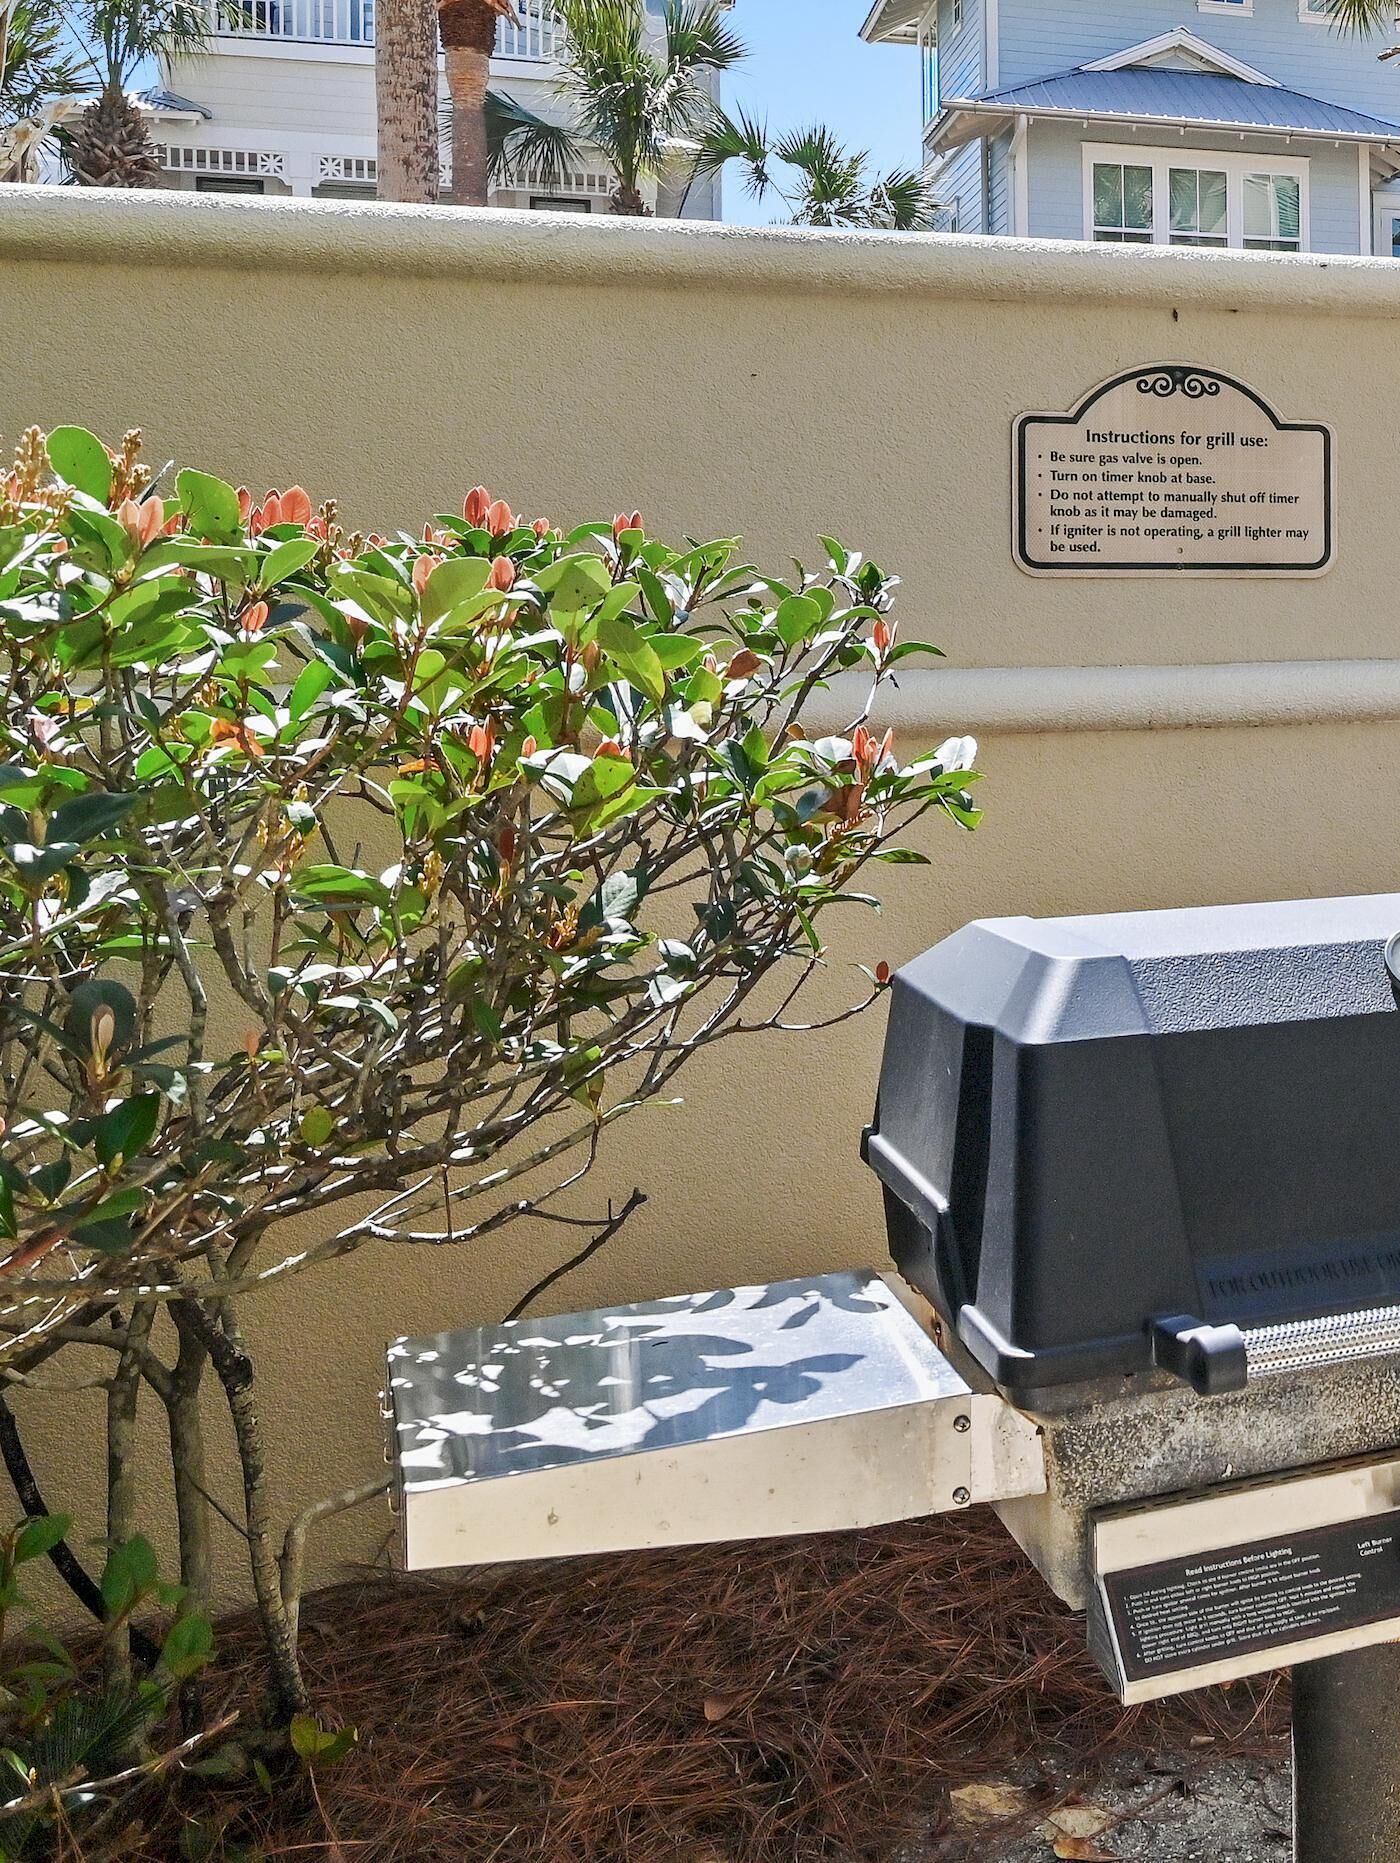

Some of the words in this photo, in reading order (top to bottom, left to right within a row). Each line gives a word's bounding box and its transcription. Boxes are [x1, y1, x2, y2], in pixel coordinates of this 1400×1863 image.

[1086, 429, 1175, 444] Instructions
[1180, 430, 1201, 445] for
[1206, 432, 1234, 449] grill
[1240, 437, 1267, 447] use:
[1050, 451, 1065, 461] Be
[1069, 454, 1095, 462] sure
[1099, 455, 1118, 466] gas
[1122, 452, 1152, 464] valve
[1157, 453, 1165, 464] is
[1169, 456, 1201, 468] open.
[1050, 470, 1077, 481] Turn
[1082, 473, 1097, 481] on
[1101, 470, 1133, 482] timer
[1137, 471, 1167, 483] knob
[1171, 473, 1182, 483] at
[1186, 472, 1215, 484] base.
[1050, 489, 1068, 500] Do
[1073, 490, 1093, 500] not
[1097, 490, 1143, 504] attempt
[1148, 491, 1159, 501] to
[1164, 491, 1217, 505] manually
[1221, 491, 1245, 502] shut
[1249, 492, 1265, 503] off
[1269, 492, 1299, 503] timer
[1050, 505, 1080, 516] knob
[1084, 508, 1097, 516] as
[1101, 505, 1109, 517] it
[1113, 509, 1138, 520] may
[1142, 506, 1156, 517] be
[1160, 506, 1216, 521] damaged.
[1051, 524, 1060, 535] If
[1063, 524, 1103, 539] igniter
[1107, 524, 1116, 536] is
[1120, 526, 1139, 536] not
[1144, 525, 1203, 540] operating,
[1207, 528, 1214, 536] a
[1218, 525, 1240, 540] grill
[1245, 526, 1281, 540] lighter
[1285, 529, 1308, 541] may
[1050, 540, 1065, 551] be
[1069, 540, 1100, 552] used.
[1357, 1541, 1371, 1550] Left
[1371, 1537, 1392, 1546] Burner
[1360, 1546, 1383, 1556] Control
[1185, 1566, 1202, 1576] Read
[1203, 1559, 1242, 1572] Instructions
[1242, 1554, 1265, 1563] Before
[1265, 1547, 1293, 1559] Lighting
